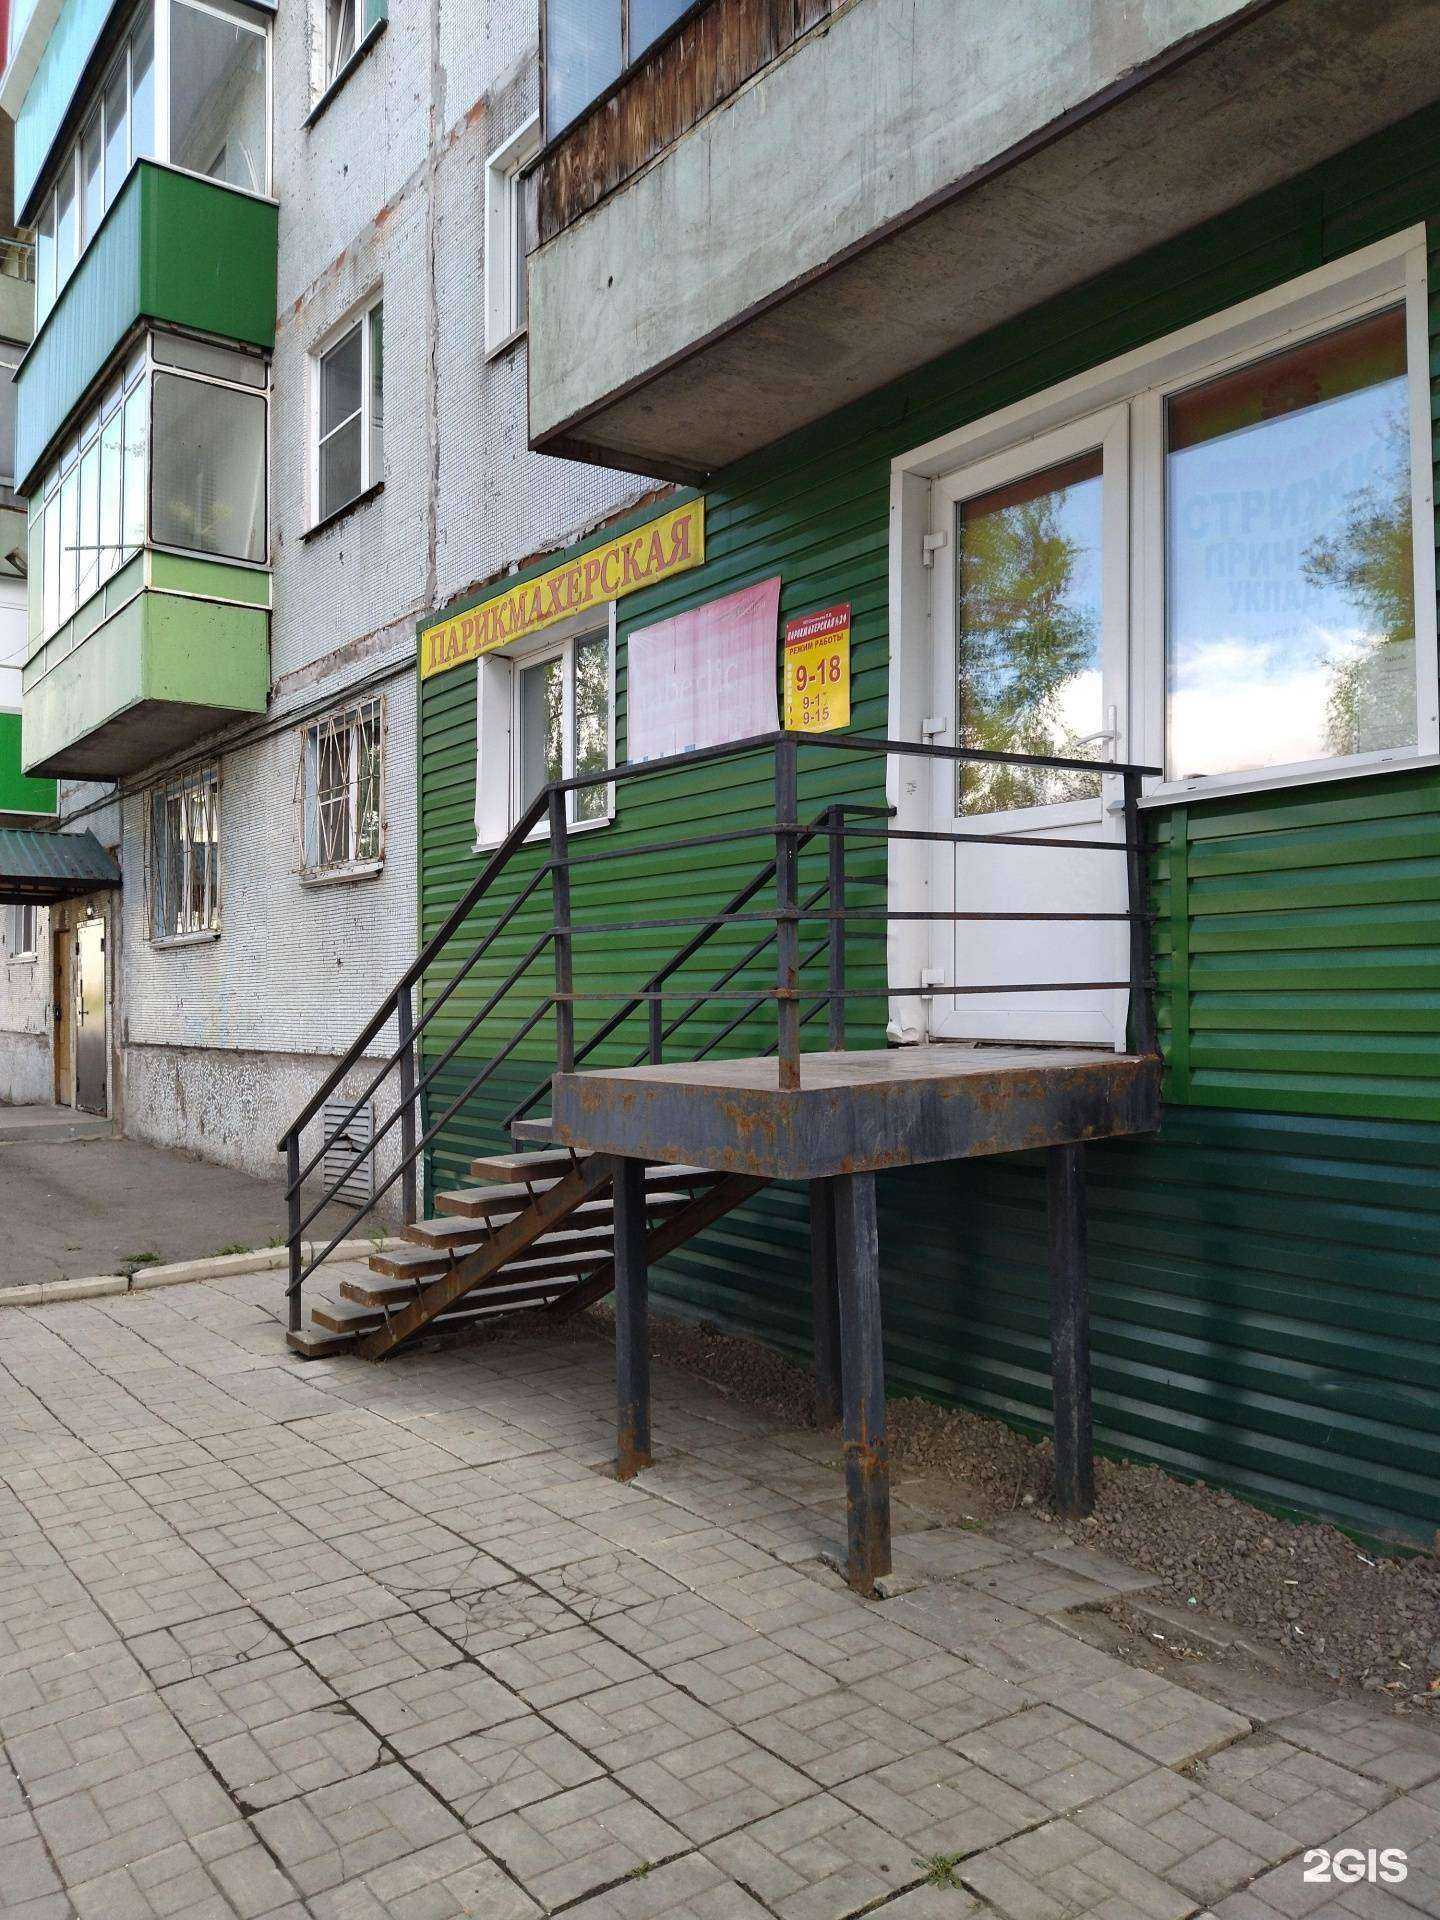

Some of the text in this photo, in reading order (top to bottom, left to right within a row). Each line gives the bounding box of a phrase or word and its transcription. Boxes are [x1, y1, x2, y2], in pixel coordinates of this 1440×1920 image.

[428, 514, 693, 670] ПАРИКМАХЕРСКАЯ
[789, 633, 844, 656] РЕЖИМ РАБОТЫ
[795, 654, 842, 693] 9-18
[802, 692, 829, 709] 9-1
[803, 706, 830, 725] 9-15
